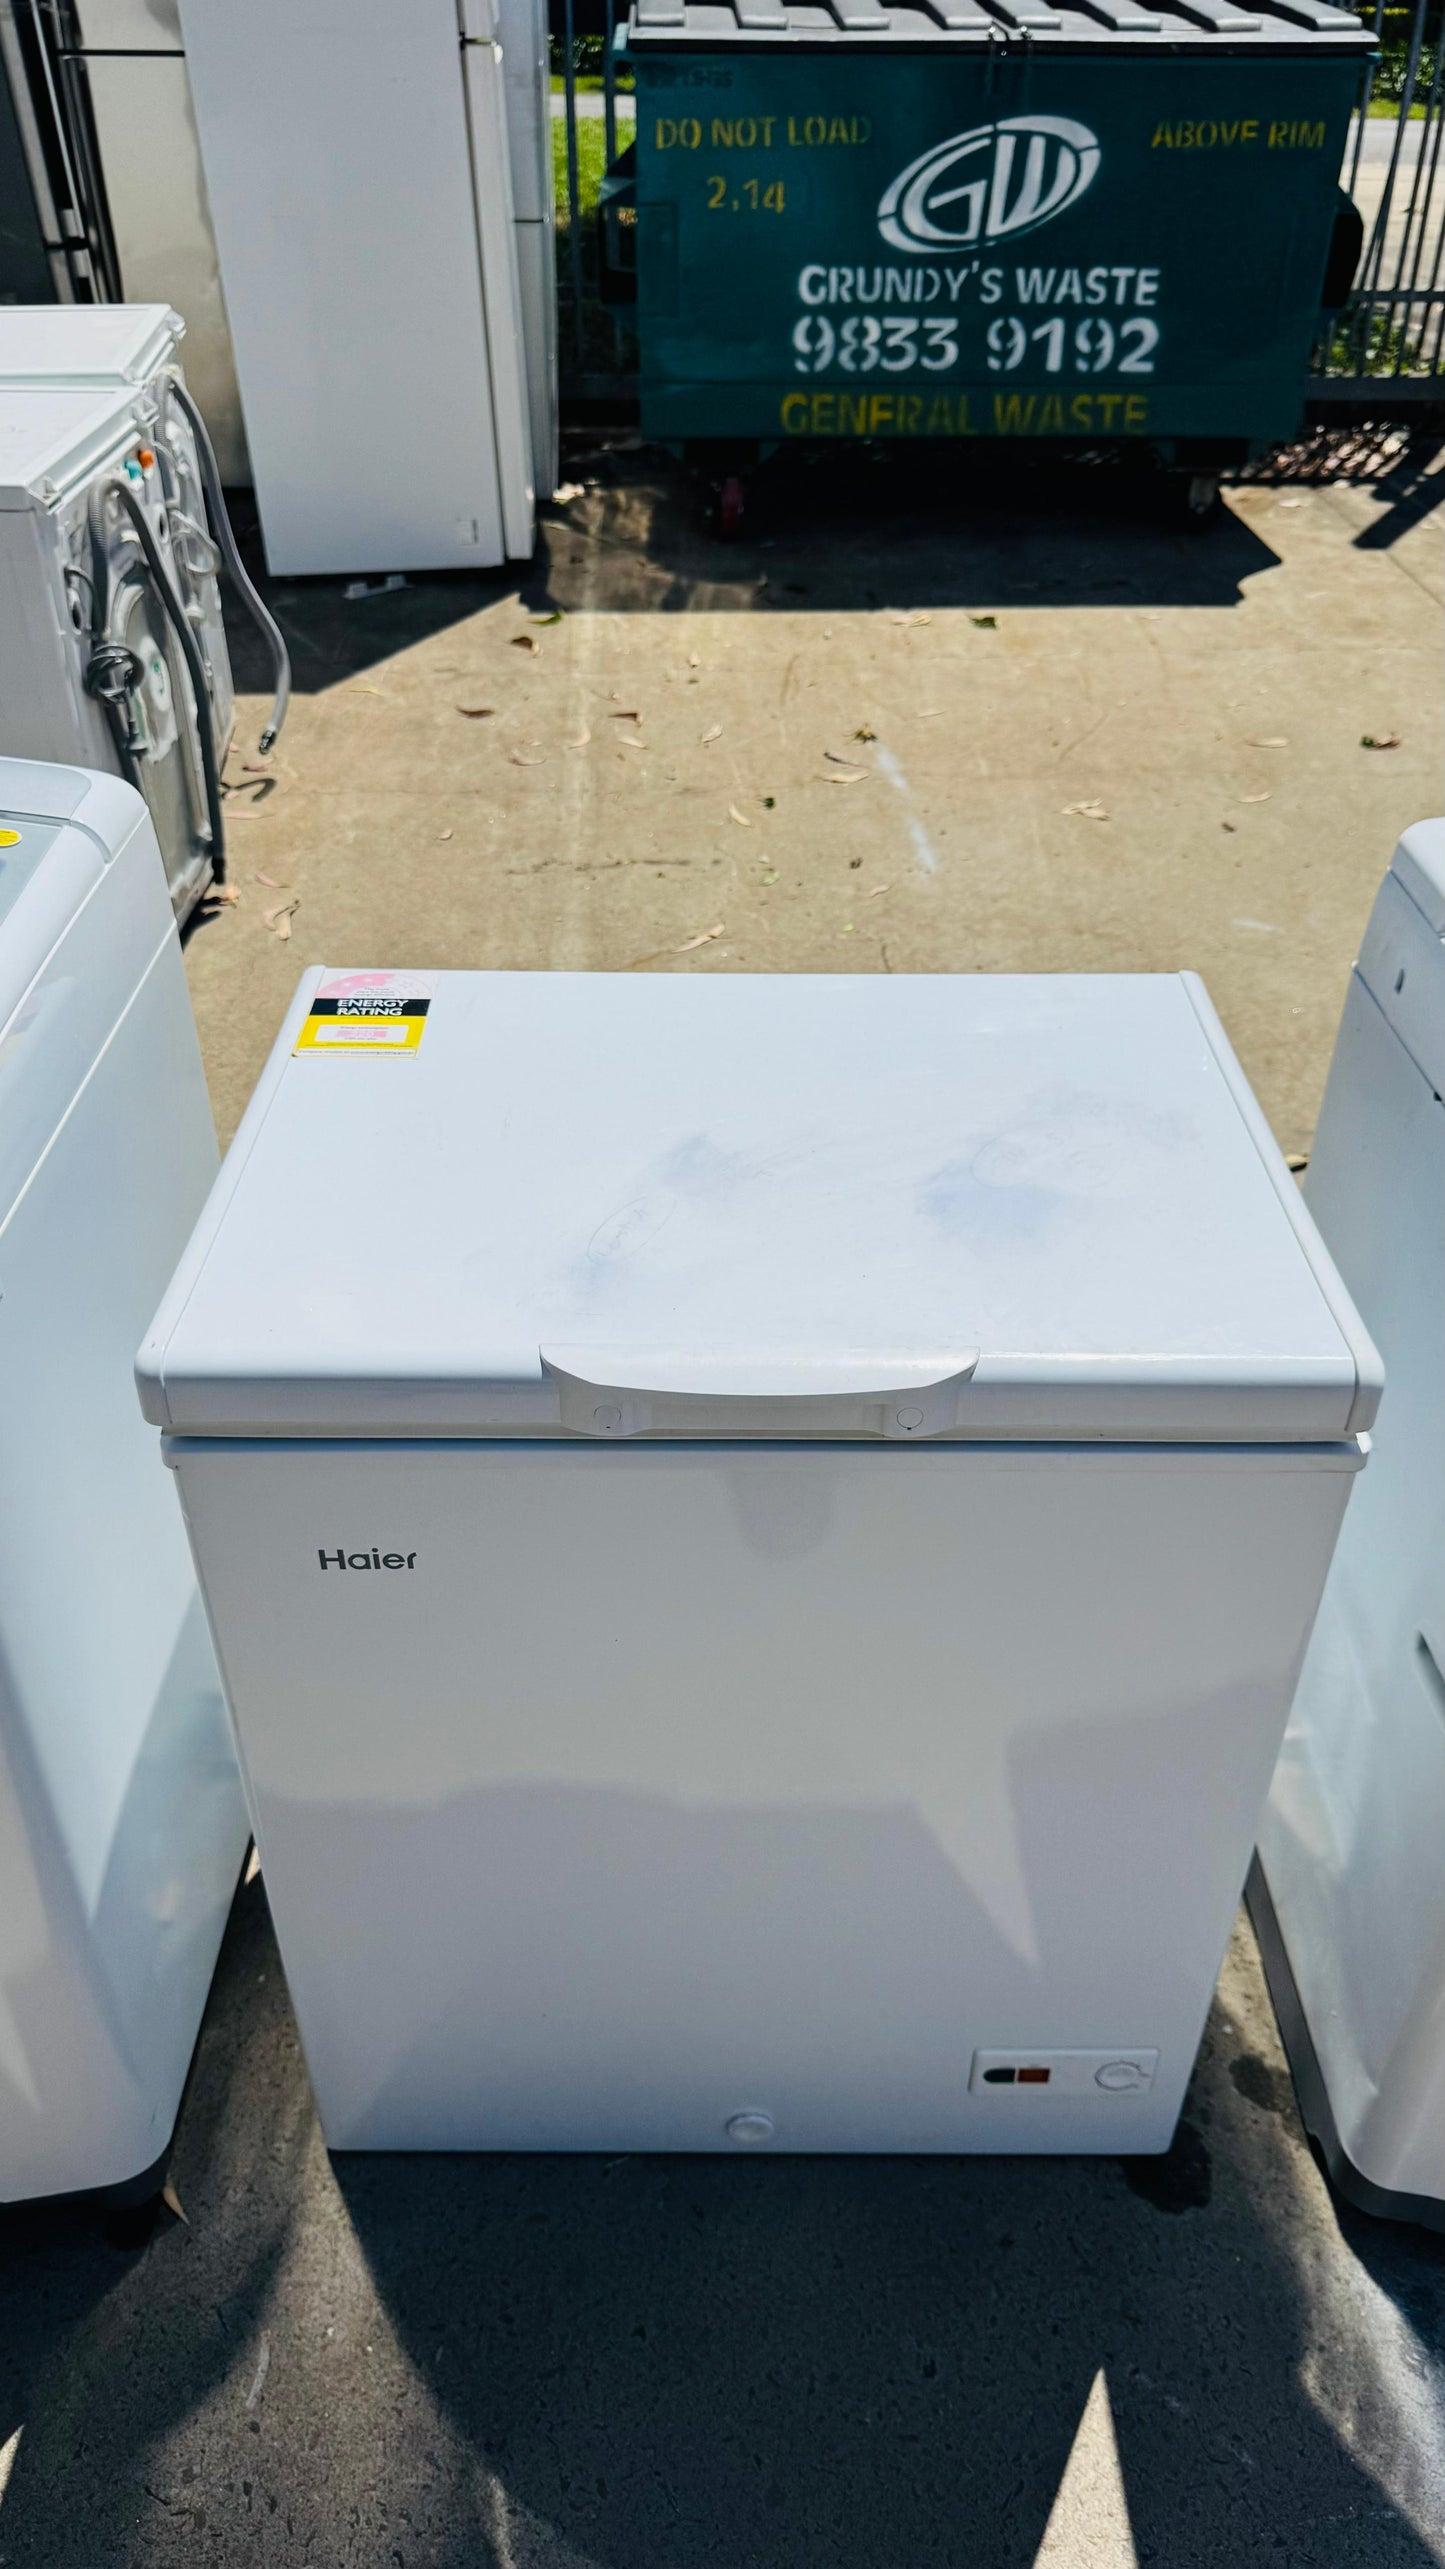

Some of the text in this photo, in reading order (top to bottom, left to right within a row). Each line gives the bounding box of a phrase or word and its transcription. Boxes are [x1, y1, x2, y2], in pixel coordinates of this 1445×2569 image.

[656, 115, 873, 150] DO NOT LOAD
[1267, 119, 1326, 149] RIM
[799, 261, 1160, 306] GRUNDY'S WASTE
[792, 314, 1160, 373] 9833 9192
[780, 393, 1150, 436] GENERAL WASTE
[336, 1007, 403, 1016] RATING
[337, 999, 409, 1007] ENERGY
[318, 1547, 418, 1570] Haier
